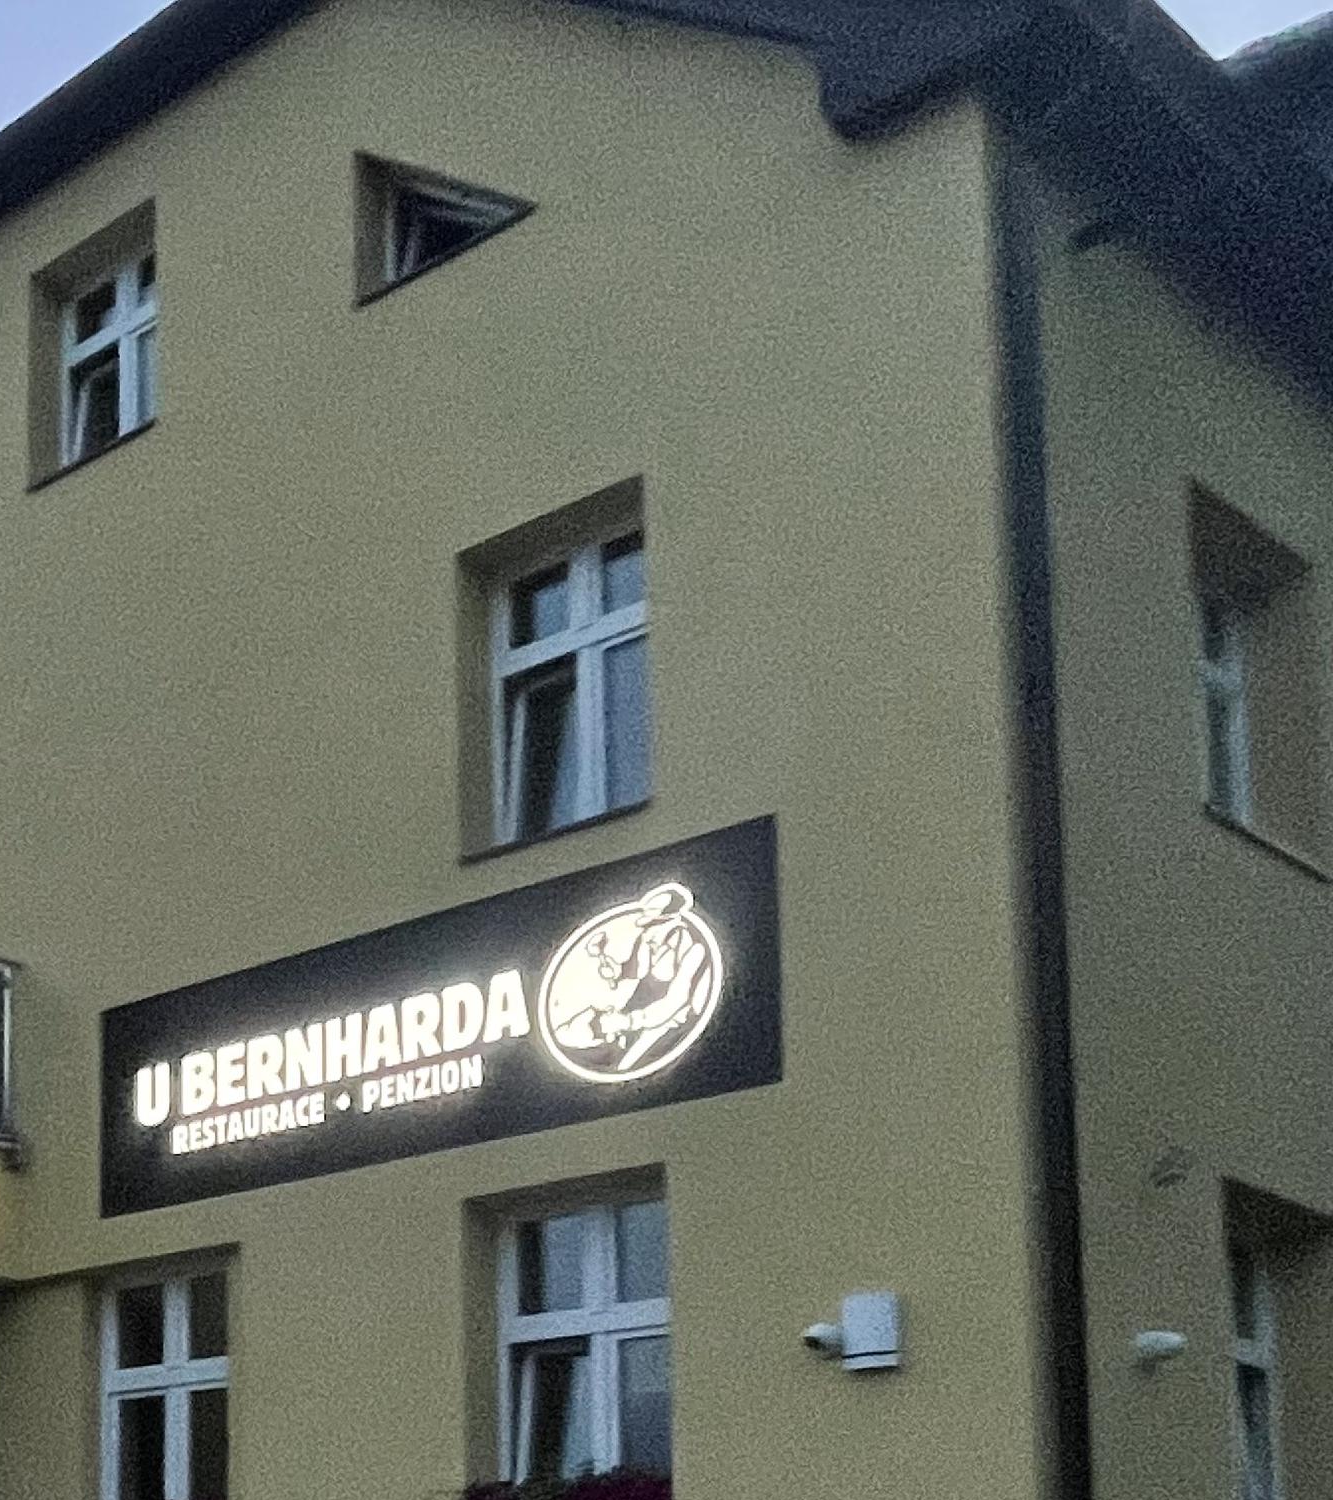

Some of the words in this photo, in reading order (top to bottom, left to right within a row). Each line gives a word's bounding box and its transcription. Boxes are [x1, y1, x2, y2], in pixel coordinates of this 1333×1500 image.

[134, 1062, 171, 1127] U
[180, 969, 530, 1115] BERNHARDA
[171, 1092, 326, 1155] RESTAURACE
[360, 1054, 484, 1113] PENZION
